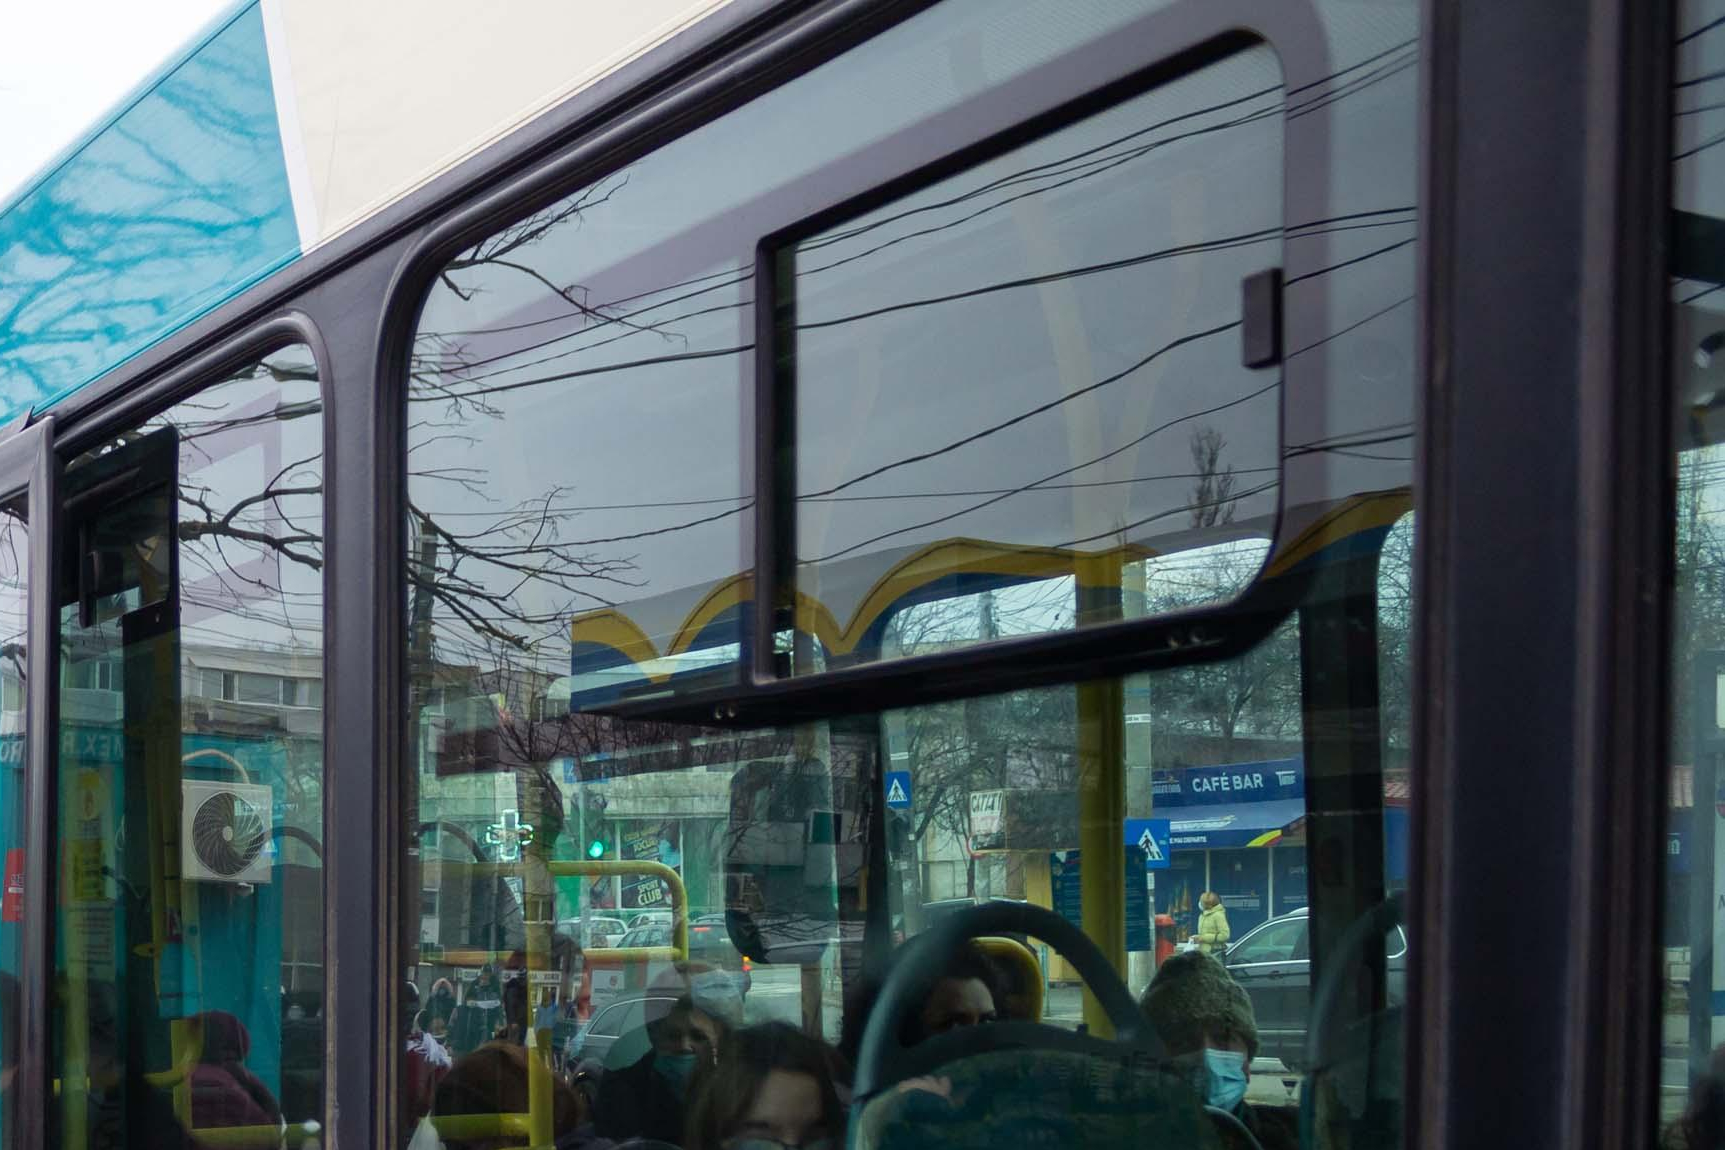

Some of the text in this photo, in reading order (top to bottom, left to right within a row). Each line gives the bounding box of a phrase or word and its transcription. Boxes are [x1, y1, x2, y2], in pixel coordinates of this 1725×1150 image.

[1192, 772, 1230, 792] CAFÉ
[1232, 773, 1263, 790] BAR
[637, 879, 659, 893] SPORT
[638, 888, 663, 905] CLUB
